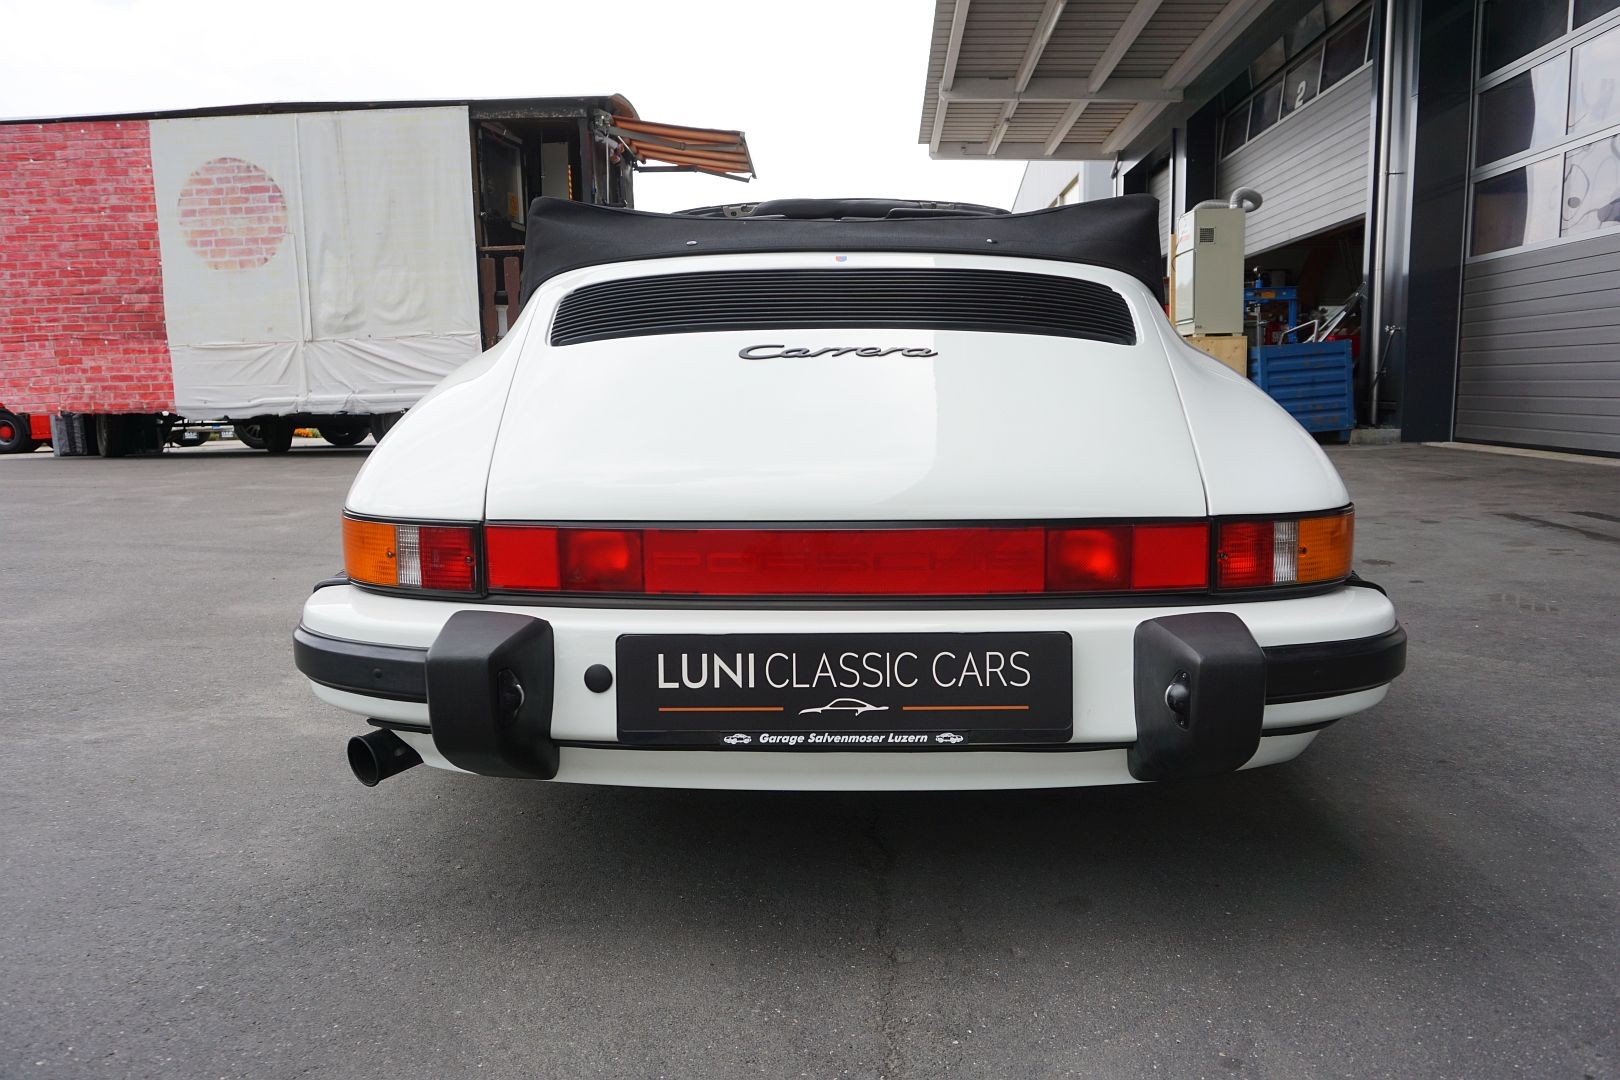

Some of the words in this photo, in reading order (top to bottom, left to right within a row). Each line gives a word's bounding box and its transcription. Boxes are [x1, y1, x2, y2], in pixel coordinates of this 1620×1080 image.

[1294, 80, 1306, 109] 2
[738, 344, 938, 360] Carrera
[657, 652, 755, 689] LUNI
[765, 651, 919, 689] CLASSIC
[932, 651, 1031, 688] CARS
[759, 733, 805, 745] Garage
[807, 732, 886, 743] Salvenmoser
[887, 732, 929, 743] Luzern
